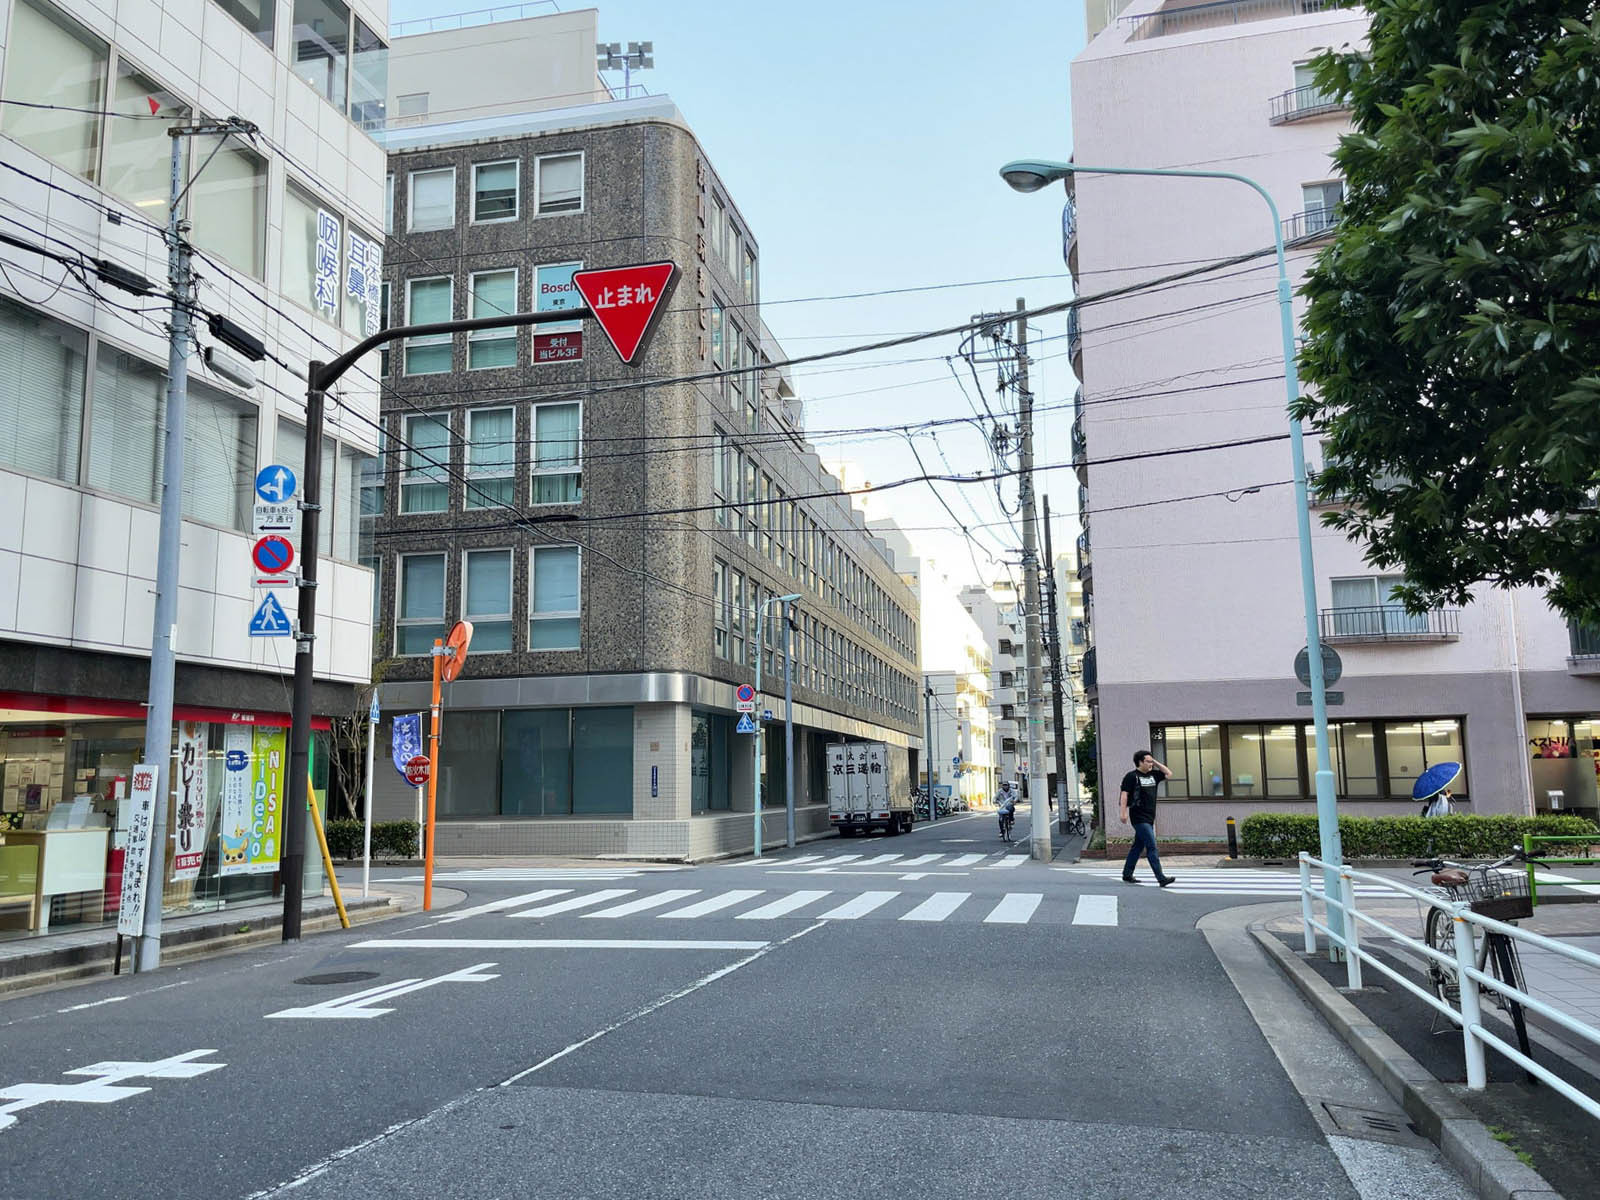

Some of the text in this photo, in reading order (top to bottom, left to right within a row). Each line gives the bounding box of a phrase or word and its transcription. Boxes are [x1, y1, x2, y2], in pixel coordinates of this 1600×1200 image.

[317, 210, 339, 317] 咽喉科
[348, 232, 367, 302] 耳鼻
[367, 241, 380, 336] 日本橋浜町
[595, 283, 656, 309] 止まれ
[540, 348, 578, 359] 当ビル3F
[550, 337, 568, 347] 受付
[256, 506, 294, 514] 自転車を除く
[256, 515, 294, 523] 一方通行
[833, 762, 882, 775] 京三運輸
[265, 750, 280, 834] NISA
[252, 759, 266, 857] iDeCo
